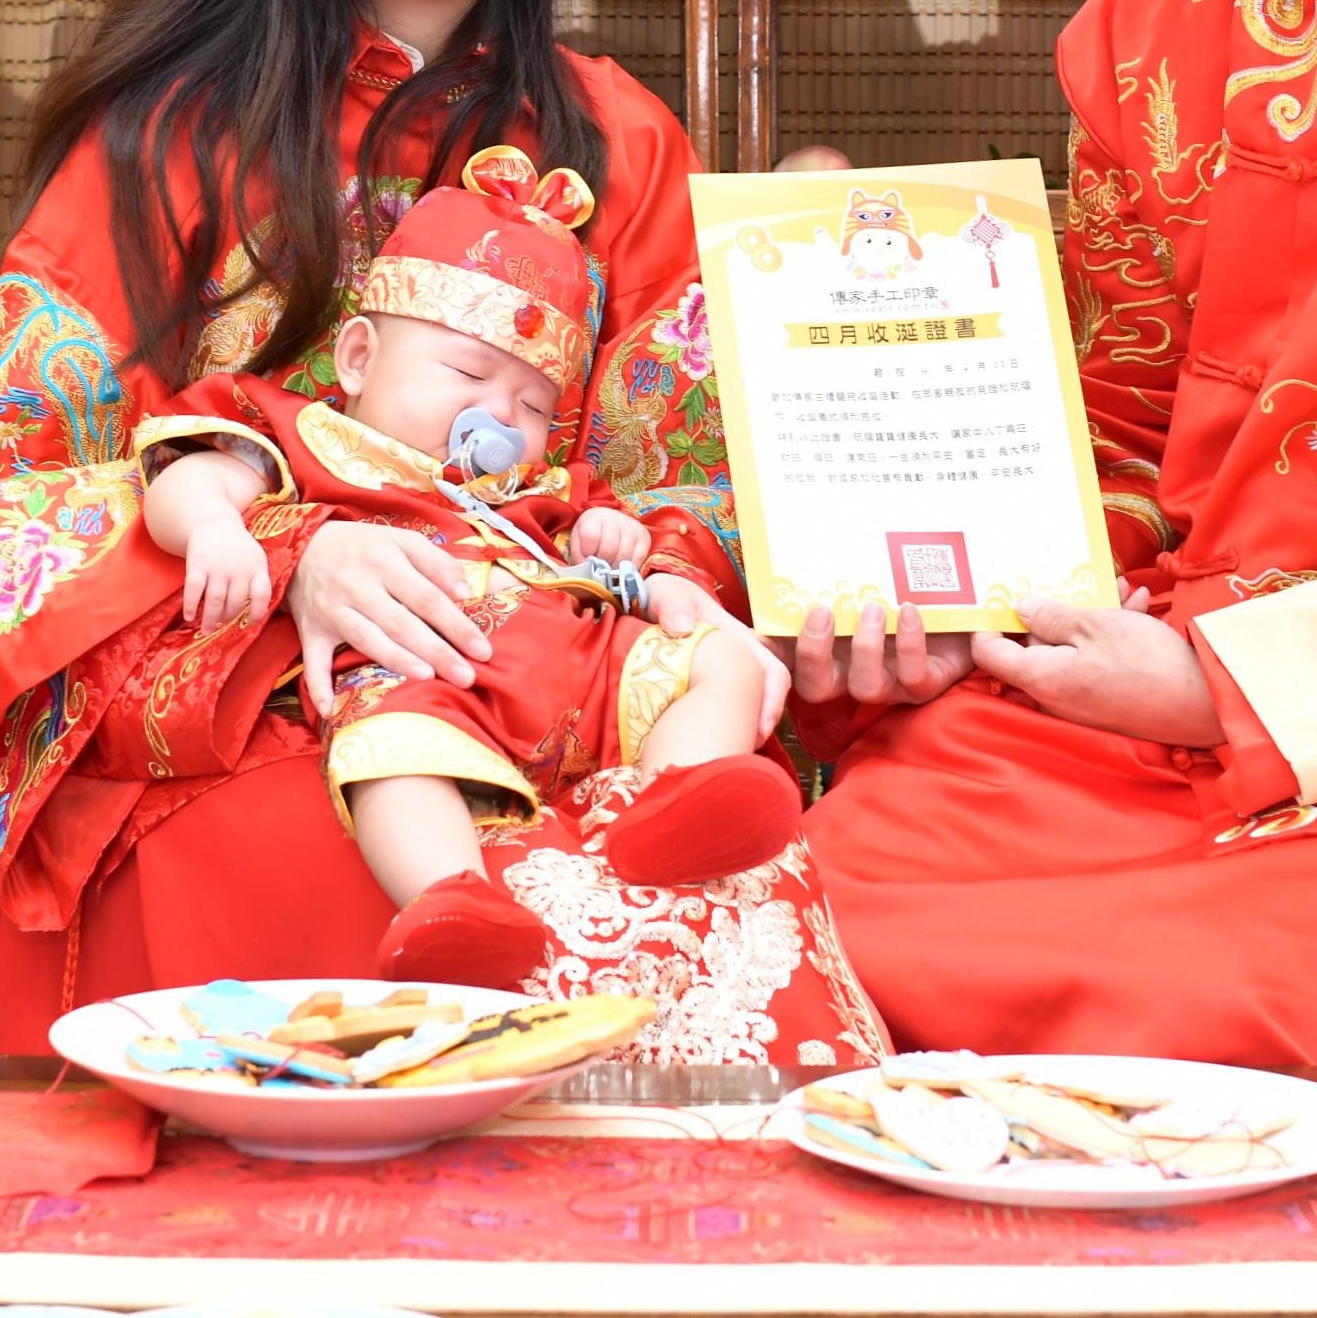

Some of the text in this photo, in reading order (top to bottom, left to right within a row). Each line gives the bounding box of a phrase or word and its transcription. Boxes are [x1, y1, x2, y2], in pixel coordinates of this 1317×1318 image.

[829, 285, 940, 306] 傳家手工印章
[808, 317, 978, 346] 四月收涎證書
